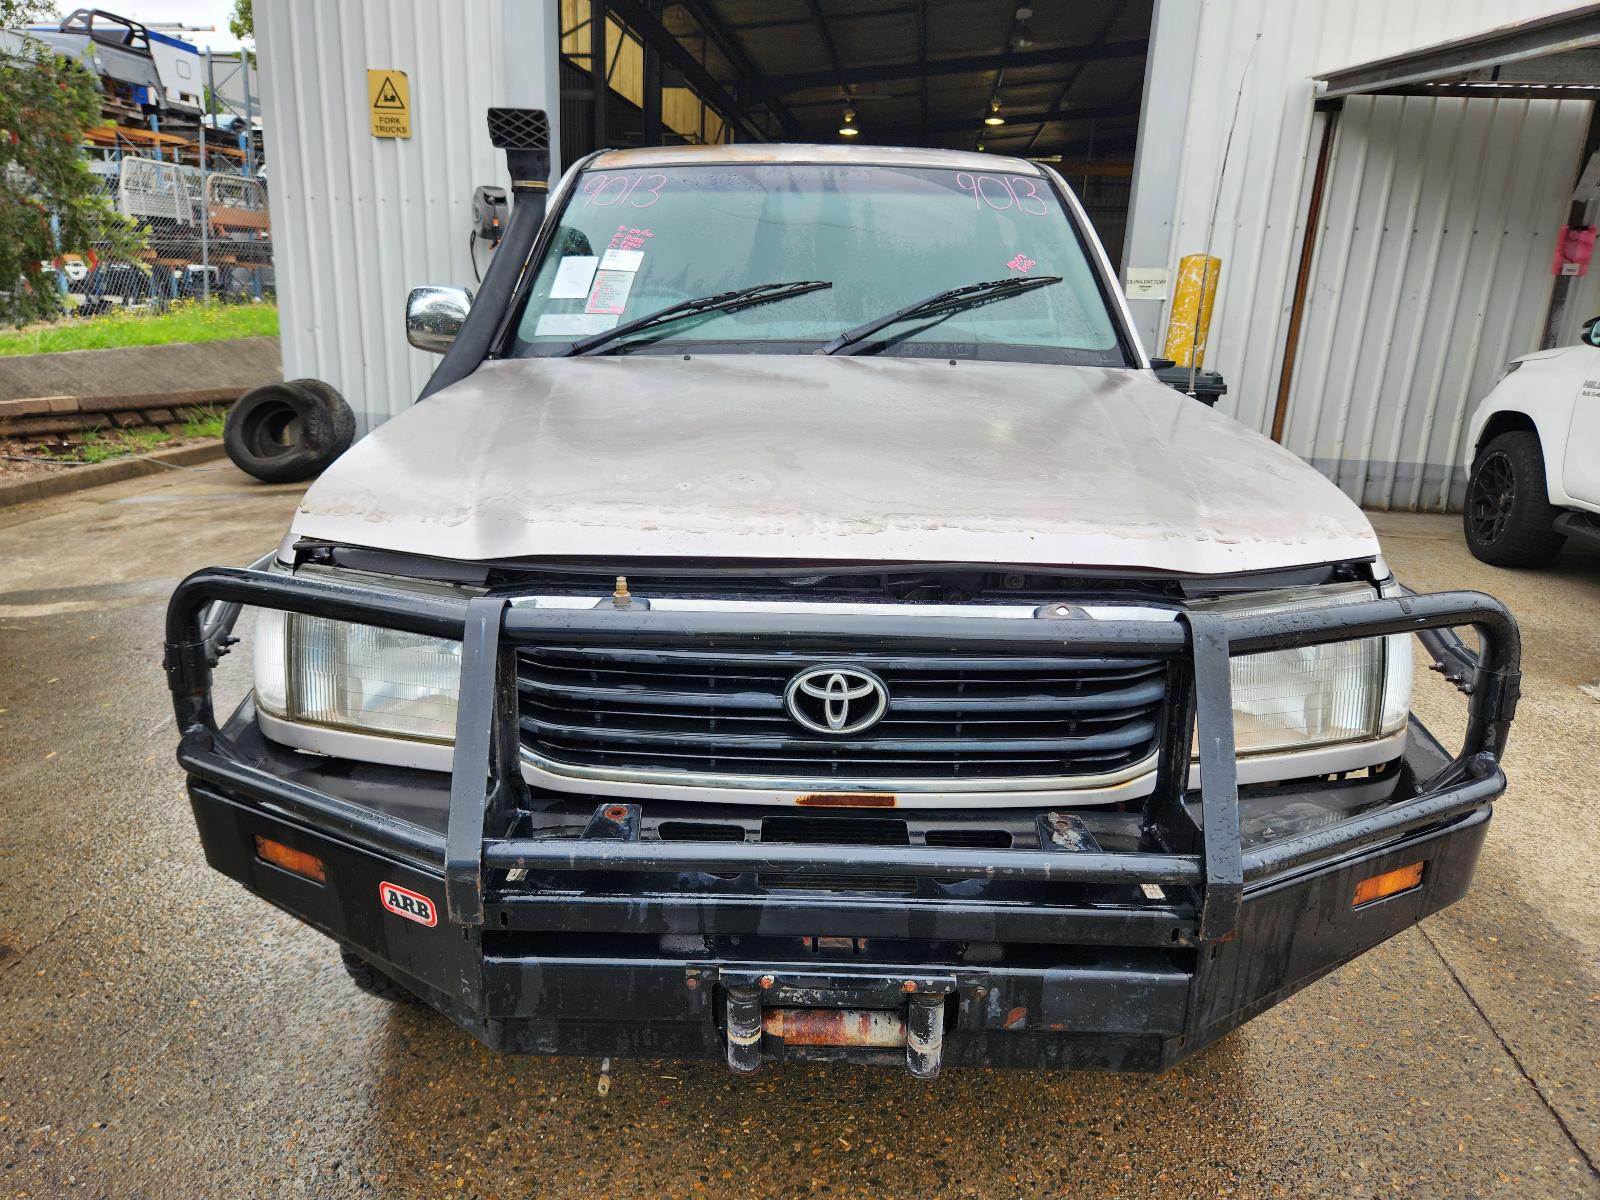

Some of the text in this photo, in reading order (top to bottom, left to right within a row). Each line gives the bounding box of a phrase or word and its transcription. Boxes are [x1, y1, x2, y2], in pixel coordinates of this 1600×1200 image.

[375, 125, 408, 134] TRUCKS
[379, 116, 401, 125] FORK
[584, 174, 667, 208] 9013
[957, 172, 1047, 215] 9013
[388, 889, 430, 920] ARB
